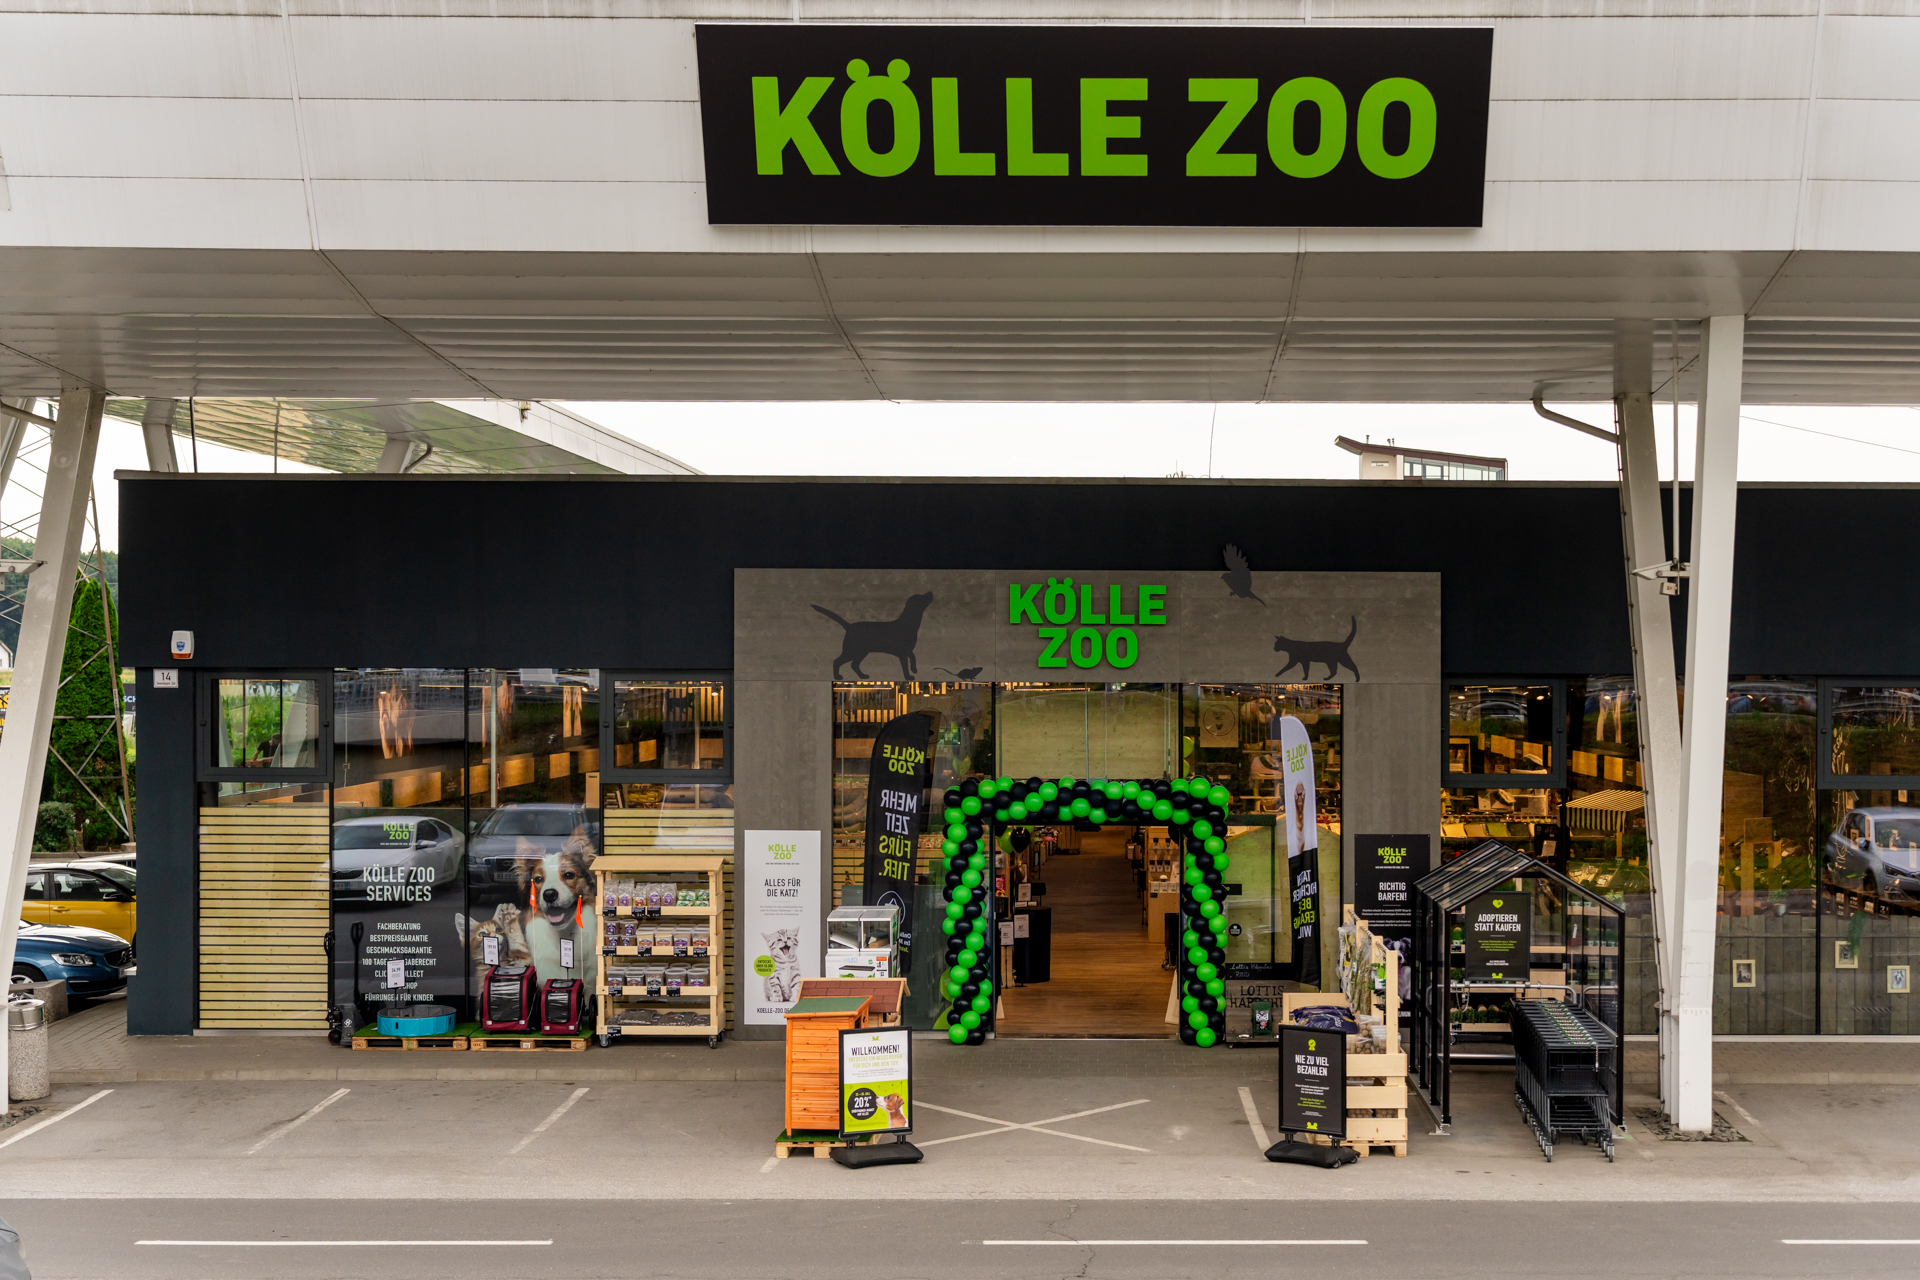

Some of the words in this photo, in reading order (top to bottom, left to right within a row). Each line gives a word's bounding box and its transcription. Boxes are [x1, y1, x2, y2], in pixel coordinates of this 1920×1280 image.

[751, 58, 1149, 178] KÖLLE
[1186, 75, 1438, 180] ZOO
[1009, 577, 1167, 625] KÖLLE
[1038, 627, 1138, 668] ZOO
[161, 672, 171, 681] 14
[383, 822, 414, 831] KÖLLE
[389, 831, 409, 840] ZOO
[768, 843, 797, 852] KÖLLE
[1377, 846, 1407, 856] KÖLLE
[773, 852, 792, 860] ZOO
[1383, 856, 1402, 864] ZOO
[363, 864, 405, 882] KÖLLE
[409, 867, 435, 882] ZOO
[764, 879, 785, 887] ALLES
[787, 877, 801, 887] FÜR
[1379, 882, 1406, 891] RICHTIG
[366, 885, 431, 901] SERVICES
[766, 889, 778, 897] DIE
[779, 889, 799, 897] KATZ!
[1377, 892, 1407, 901] BARFEN!
[1477, 913, 1518, 922] ADOPTIEREN
[377, 922, 421, 930] FACHBERATUNG
[1474, 923, 1494, 931] STATT
[1495, 923, 1521, 932] KAUFEN
[369, 934, 428, 942] BESTPREISGARANTIE
[366, 946, 432, 954] GESCHMACKSGARANTIE
[1240, 985, 1285, 996] LOTTIS
[364, 993, 398, 1001] FÜHRUNGEN
[400, 993, 411, 1001] FÜR
[851, 1044, 900, 1056] WILLKOMMEN!
[1295, 1054, 1305, 1064] NIE
[1306, 1055, 1315, 1065] ZU
[1315, 1056, 1329, 1067] VIEL
[1297, 1064, 1328, 1077] BEZAHLEN
